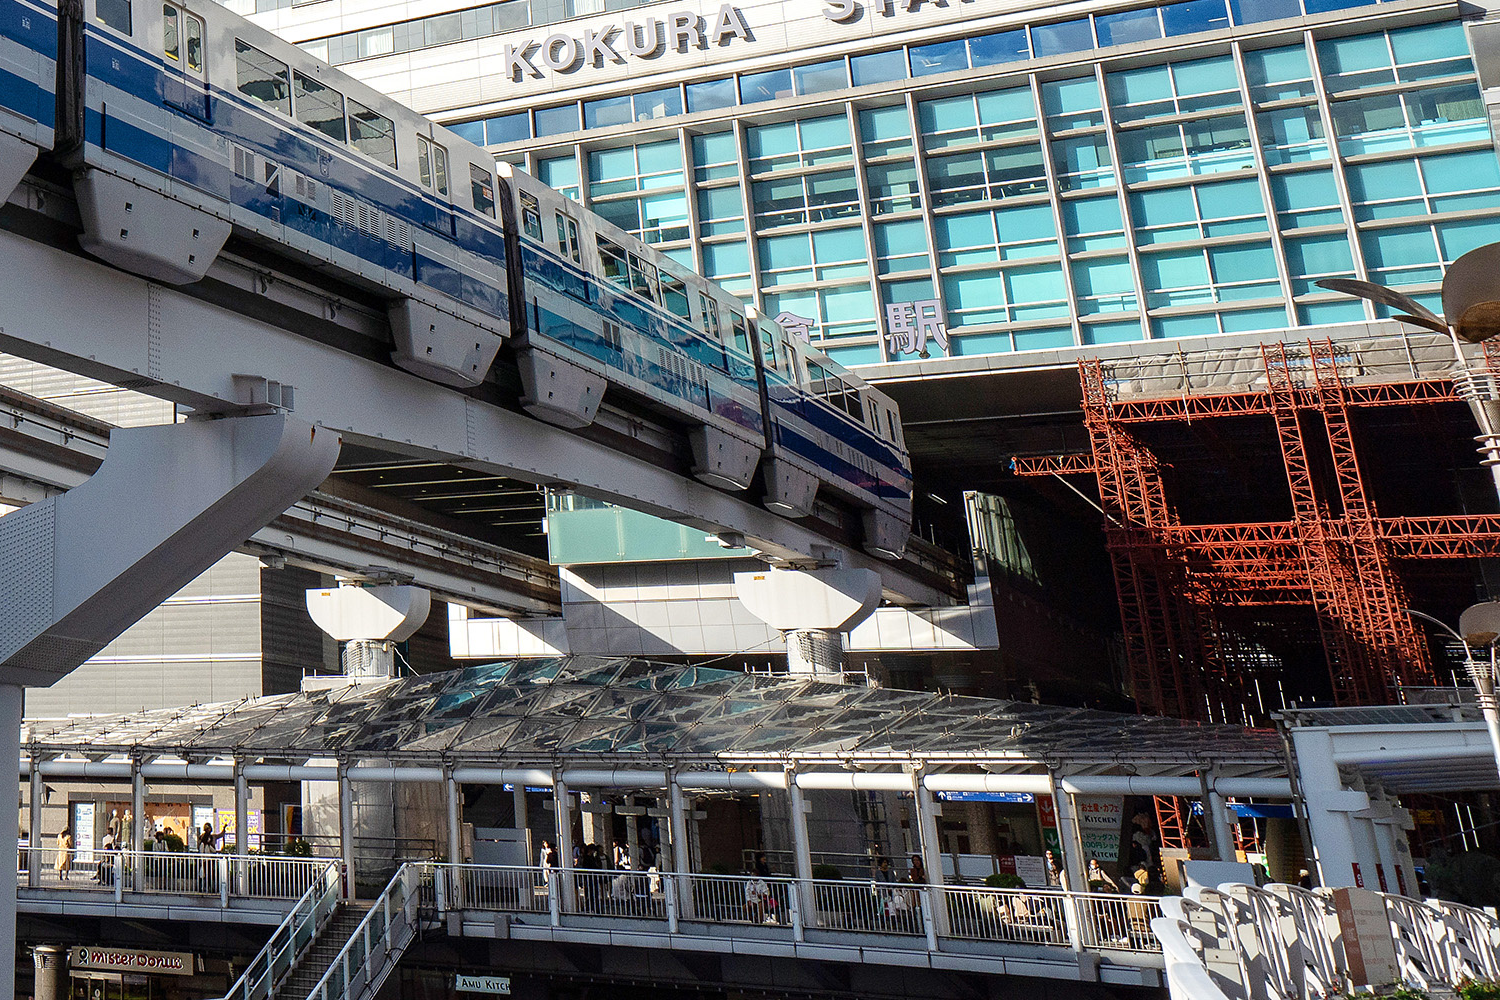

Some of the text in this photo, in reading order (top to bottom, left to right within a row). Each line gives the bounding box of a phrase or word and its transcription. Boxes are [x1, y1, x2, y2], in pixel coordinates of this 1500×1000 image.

[503, 3, 749, 80] KOKURA
[1084, 815, 1118, 824] KITCHEN
[137, 954, 183, 970] Donut
